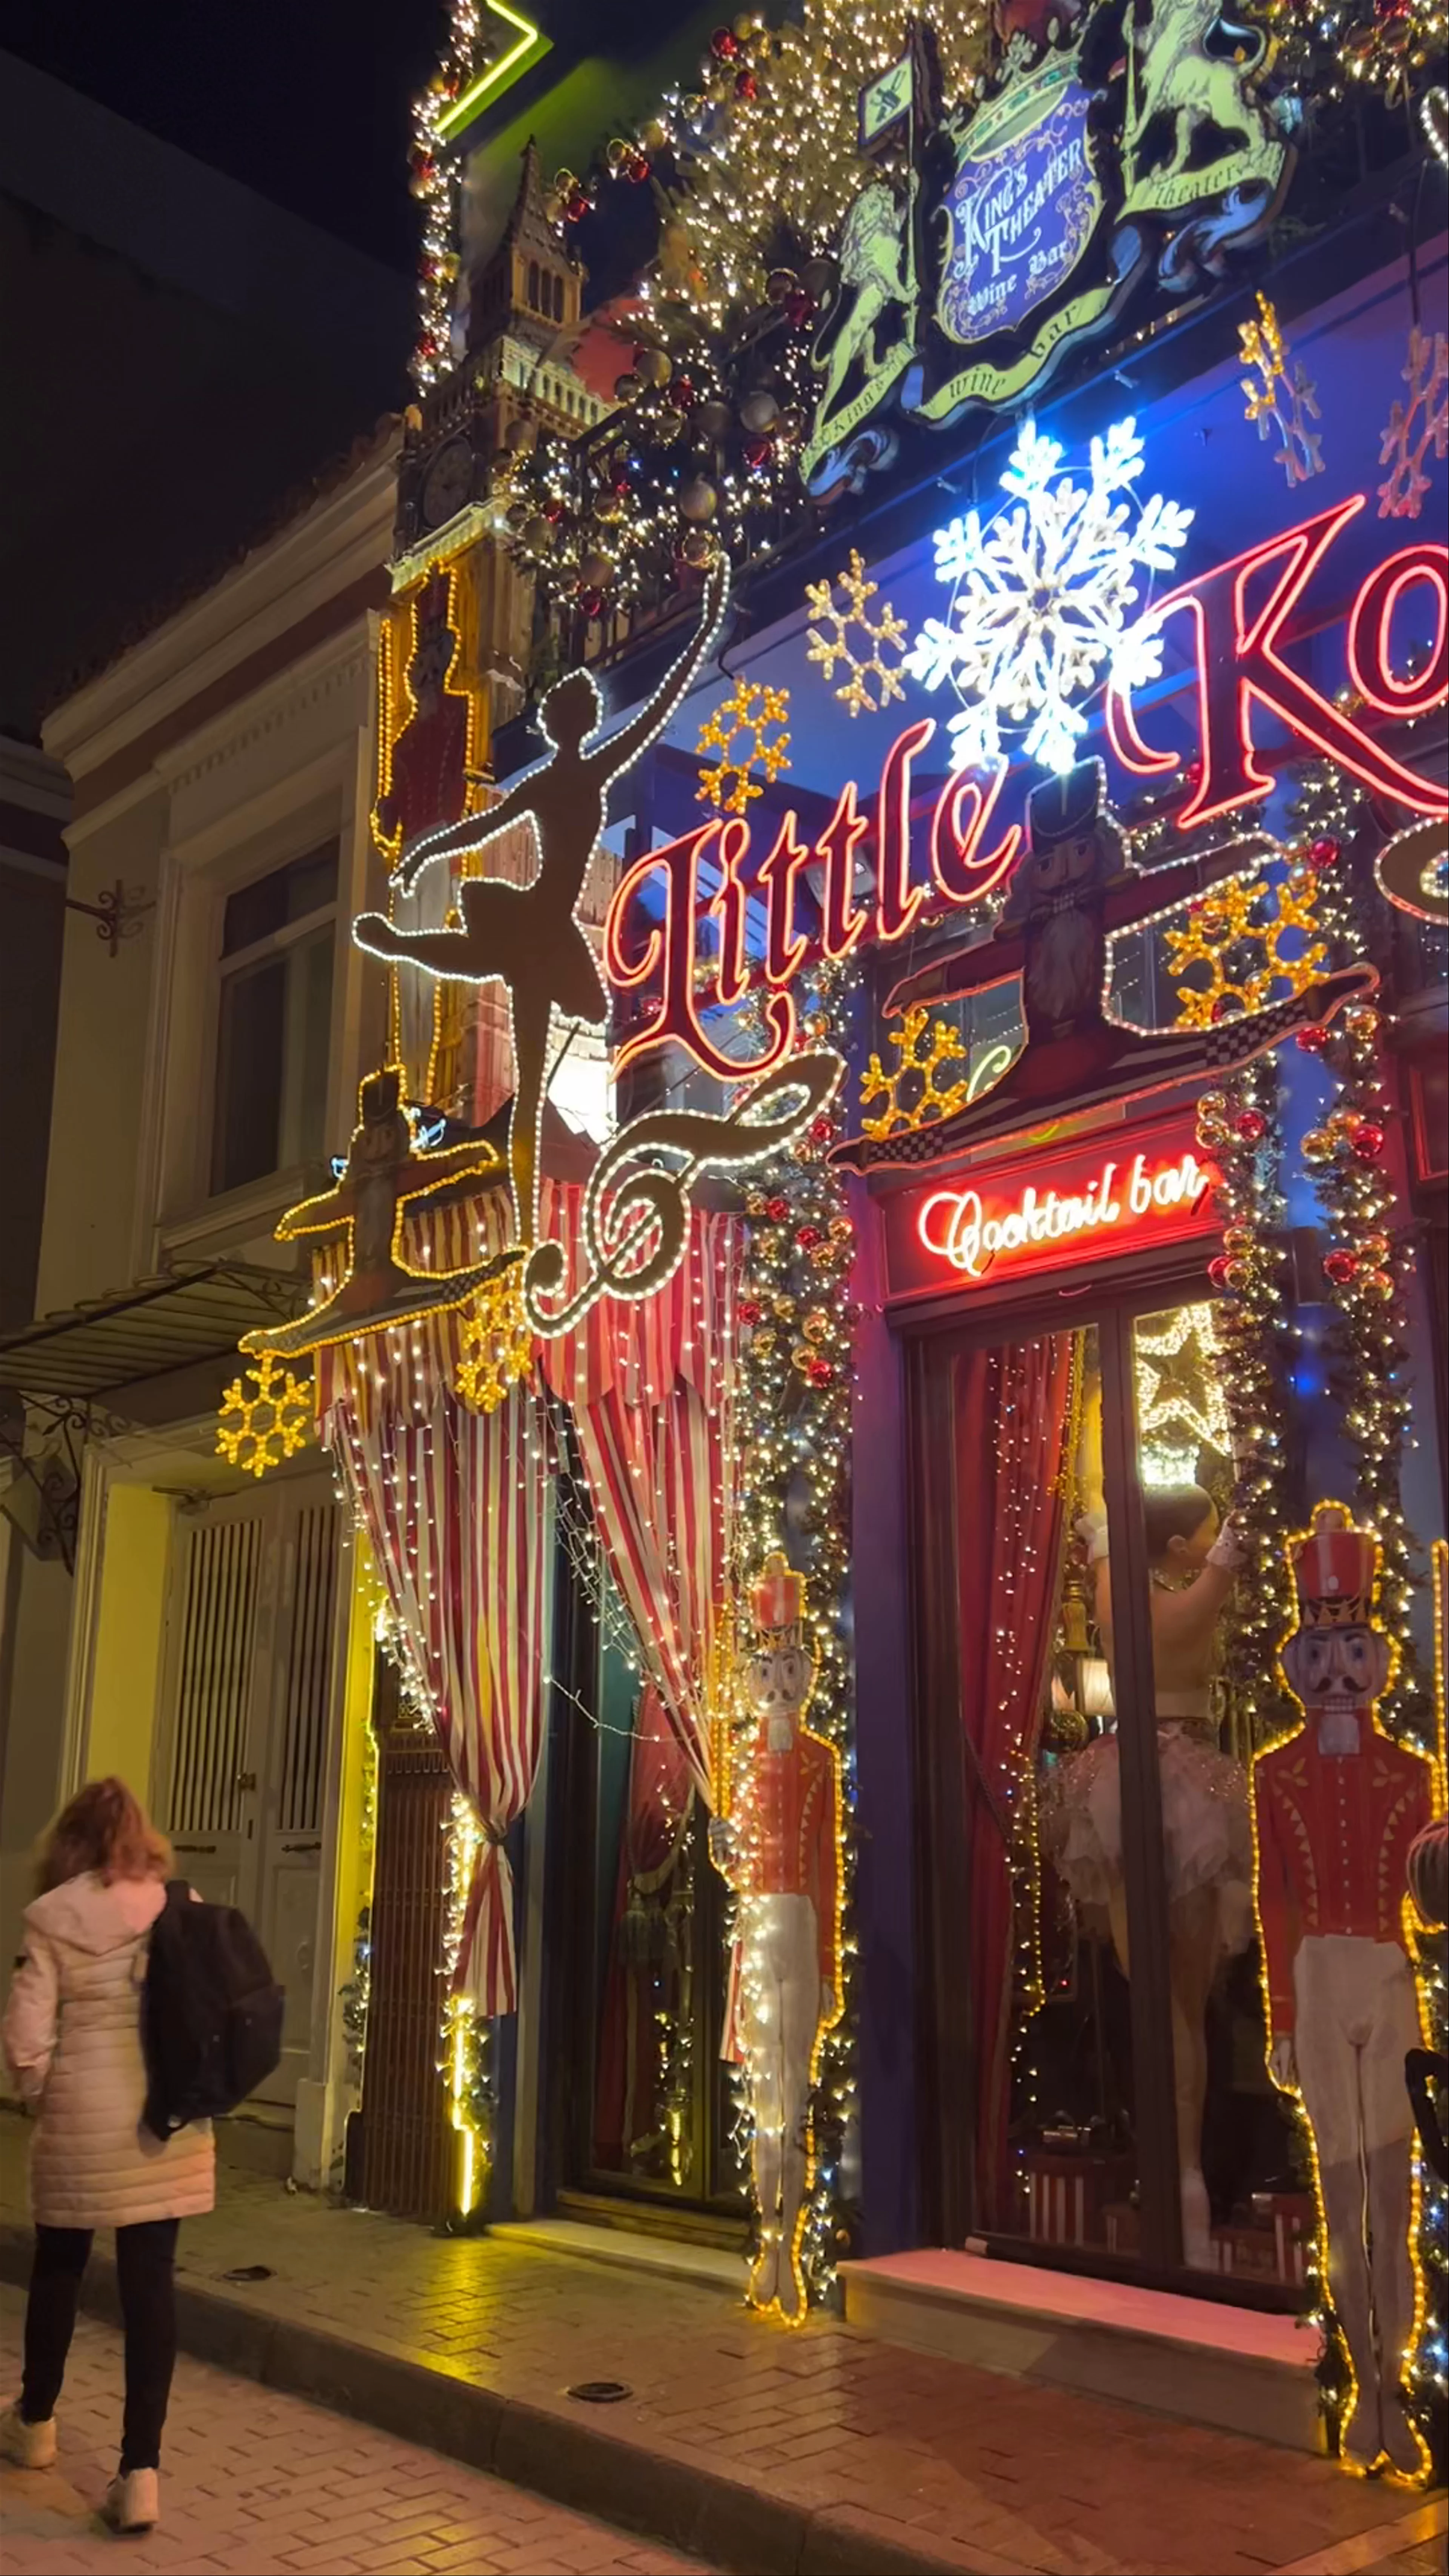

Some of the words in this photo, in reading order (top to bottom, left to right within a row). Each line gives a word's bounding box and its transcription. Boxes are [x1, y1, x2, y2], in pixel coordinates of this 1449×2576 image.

[983, 138, 1082, 277] THEATER
[968, 274, 1017, 315] Wine
[1029, 240, 1068, 274] Bar
[950, 367, 1006, 398] wine
[1031, 306, 1076, 358] bar
[605, 718, 1021, 1083] Little
[918, 1164, 1120, 1277] Cocktail
[1131, 1154, 1209, 1213] bar
